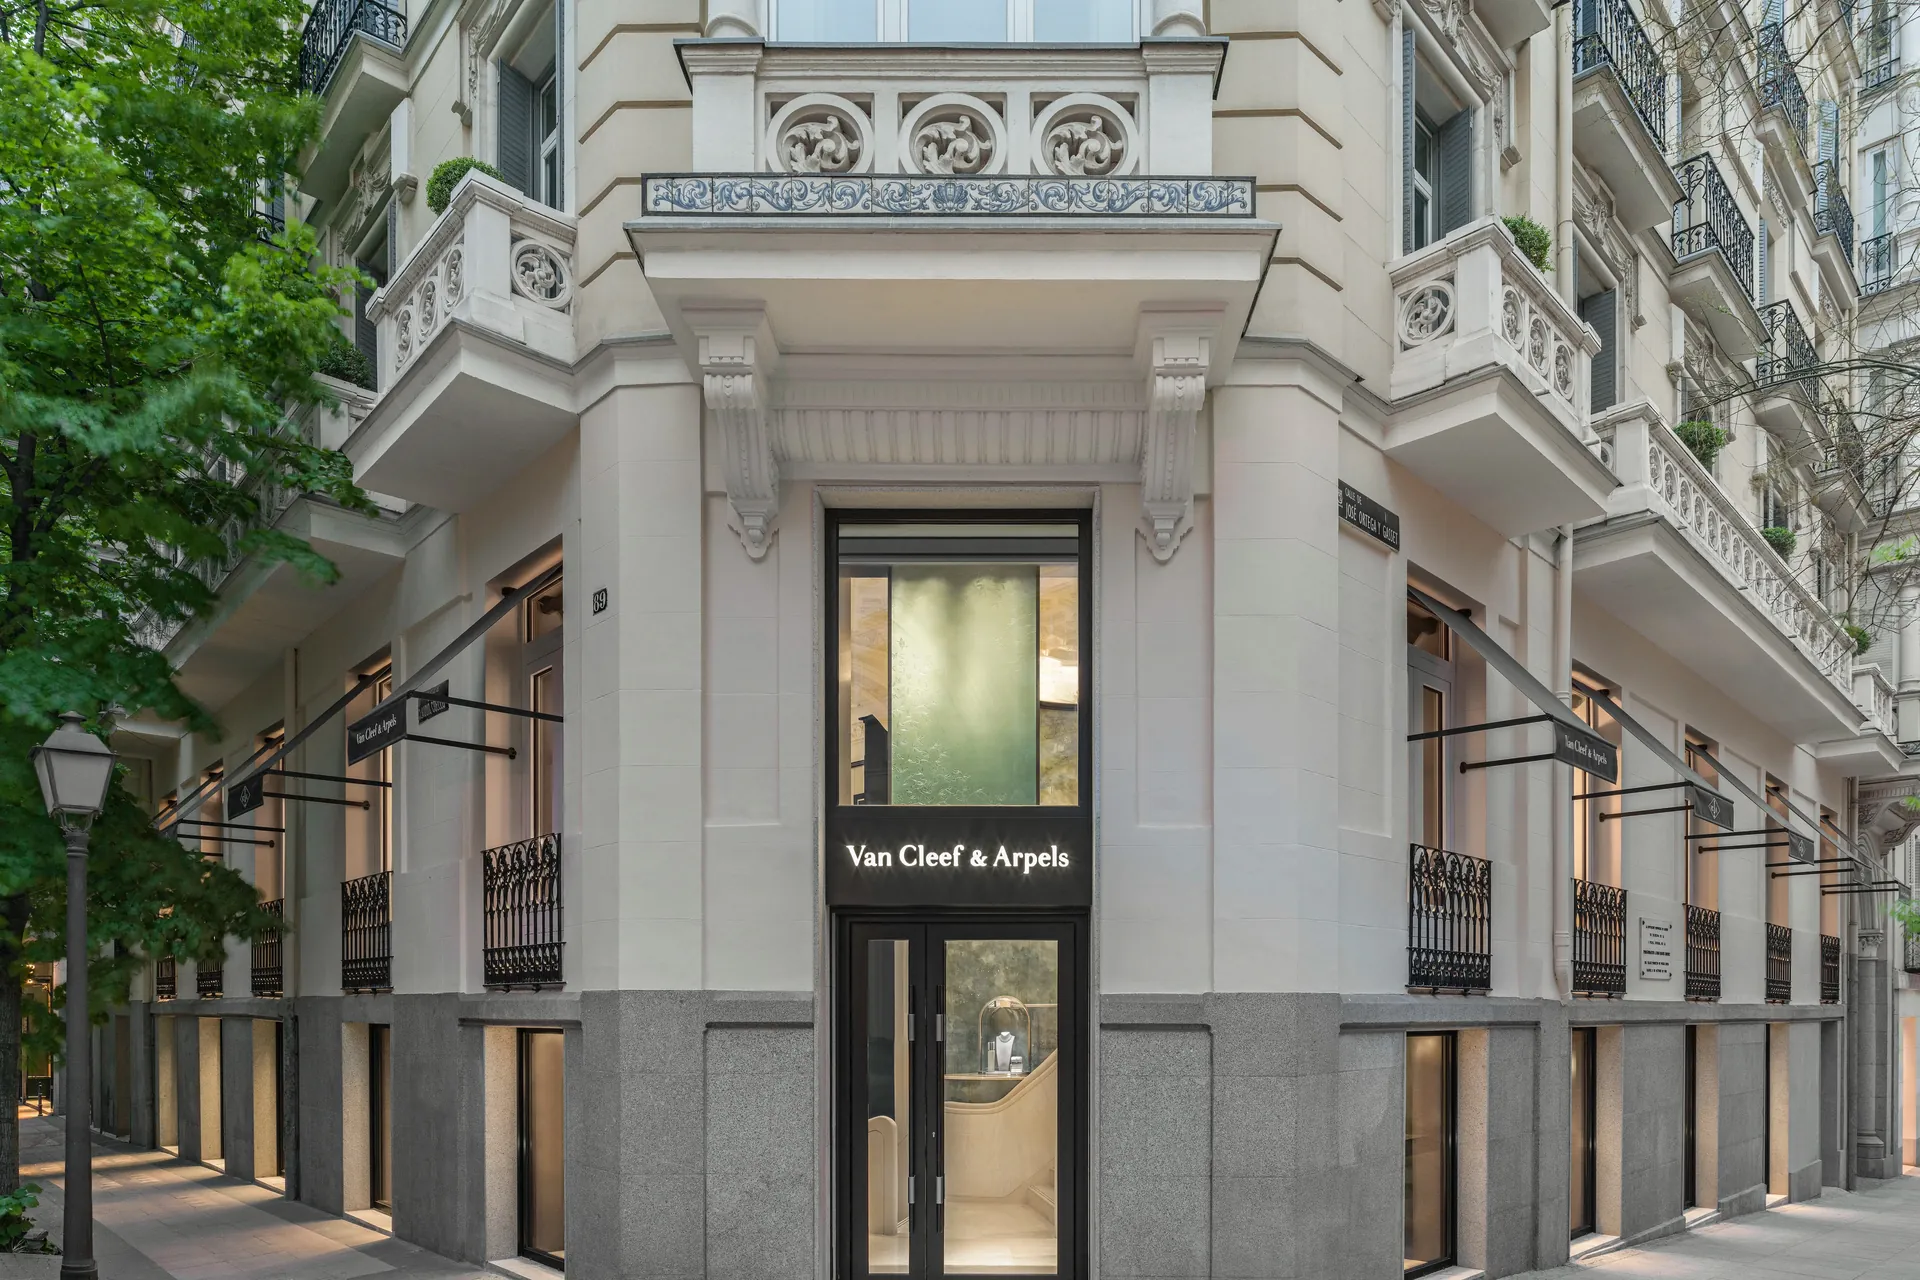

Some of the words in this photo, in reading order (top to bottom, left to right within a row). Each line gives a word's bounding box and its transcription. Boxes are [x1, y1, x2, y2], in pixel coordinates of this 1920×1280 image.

[1345, 502, 1357, 520] JOSÉ
[1358, 510, 1377, 533] ORTEGA
[1382, 525, 1398, 545] GASSET
[594, 591, 606, 612] 89
[356, 732, 365, 744] Van
[365, 723, 378, 741] Cleef
[382, 713, 397, 734] Arpels
[1564, 734, 1575, 750] Van
[1574, 740, 1588, 756] Cleef
[1592, 748, 1608, 766] Arpels
[846, 844, 892, 867] Van
[899, 844, 965, 867] Cleef
[970, 848, 988, 867] &
[993, 844, 1070, 875] Arpels
